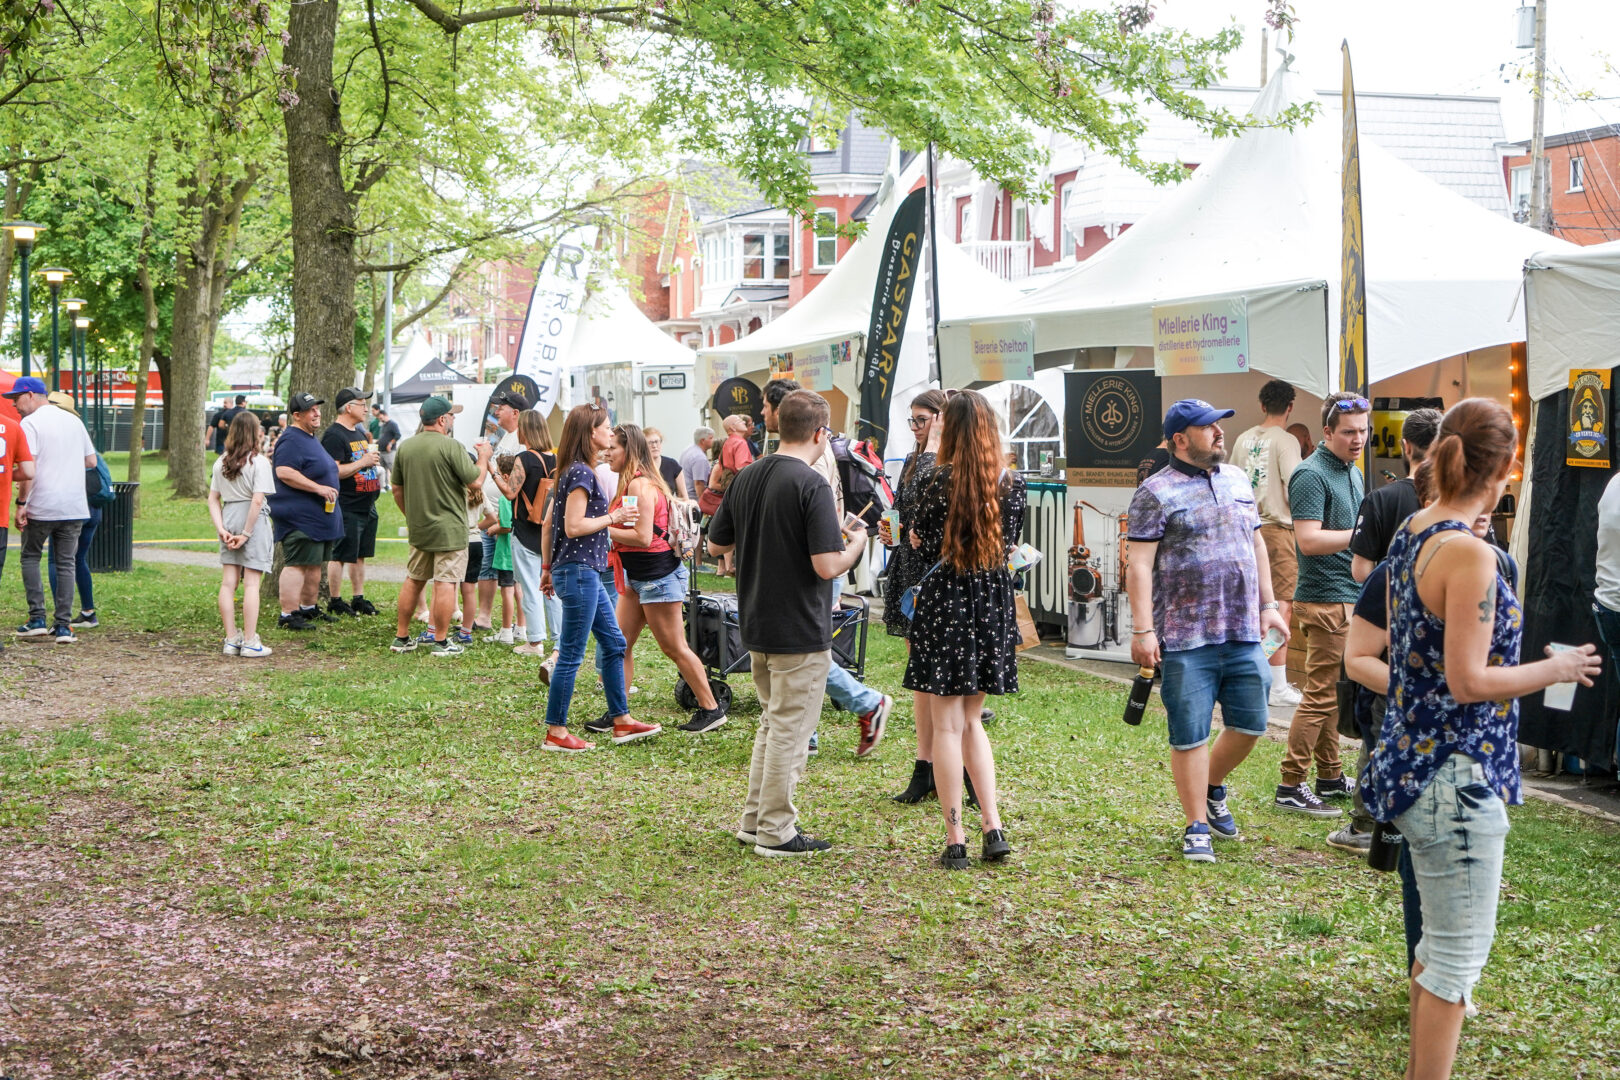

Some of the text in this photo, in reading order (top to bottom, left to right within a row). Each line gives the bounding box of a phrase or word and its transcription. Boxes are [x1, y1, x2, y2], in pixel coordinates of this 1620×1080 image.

[1158, 315, 1200, 335] Miellerie
[1202, 313, 1228, 334] King
[999, 339, 1028, 353] Shelton
[1159, 336, 1241, 351] distillerie et hydromellerie
[1085, 380, 1139, 413] MIELLERIE KING
